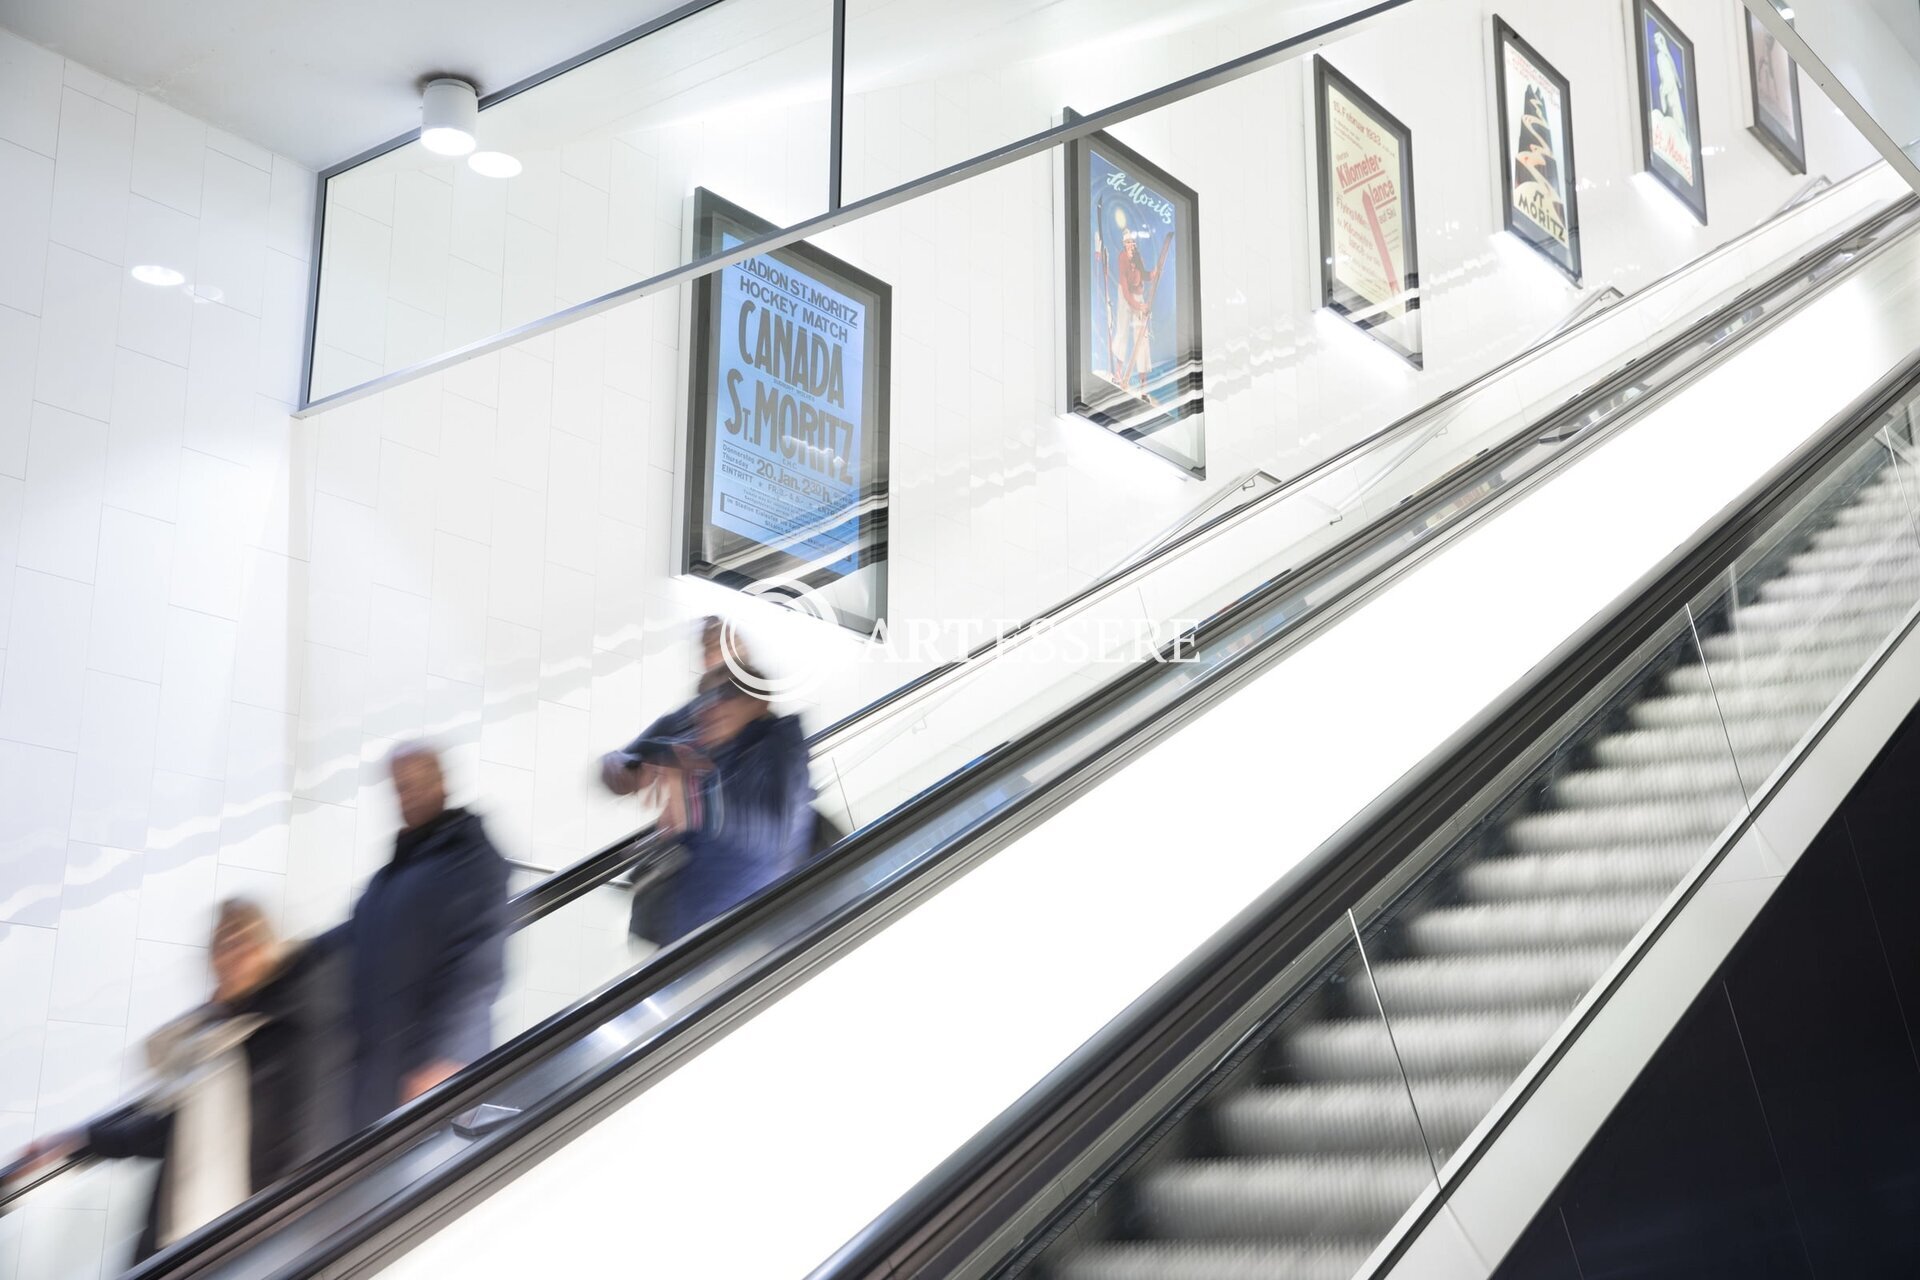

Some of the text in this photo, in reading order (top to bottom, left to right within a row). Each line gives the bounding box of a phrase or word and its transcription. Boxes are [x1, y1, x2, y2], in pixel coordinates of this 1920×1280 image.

[1122, 182, 1173, 225] Moritz
[735, 258, 789, 290] TADION
[740, 275, 848, 343] HOCKEY MATCH
[738, 300, 845, 409] CANADA
[721, 463, 752, 483] EINTRITT
[722, 451, 748, 469] Thursday
[756, 457, 776, 481] 20.
[778, 466, 800, 491] Jan.
